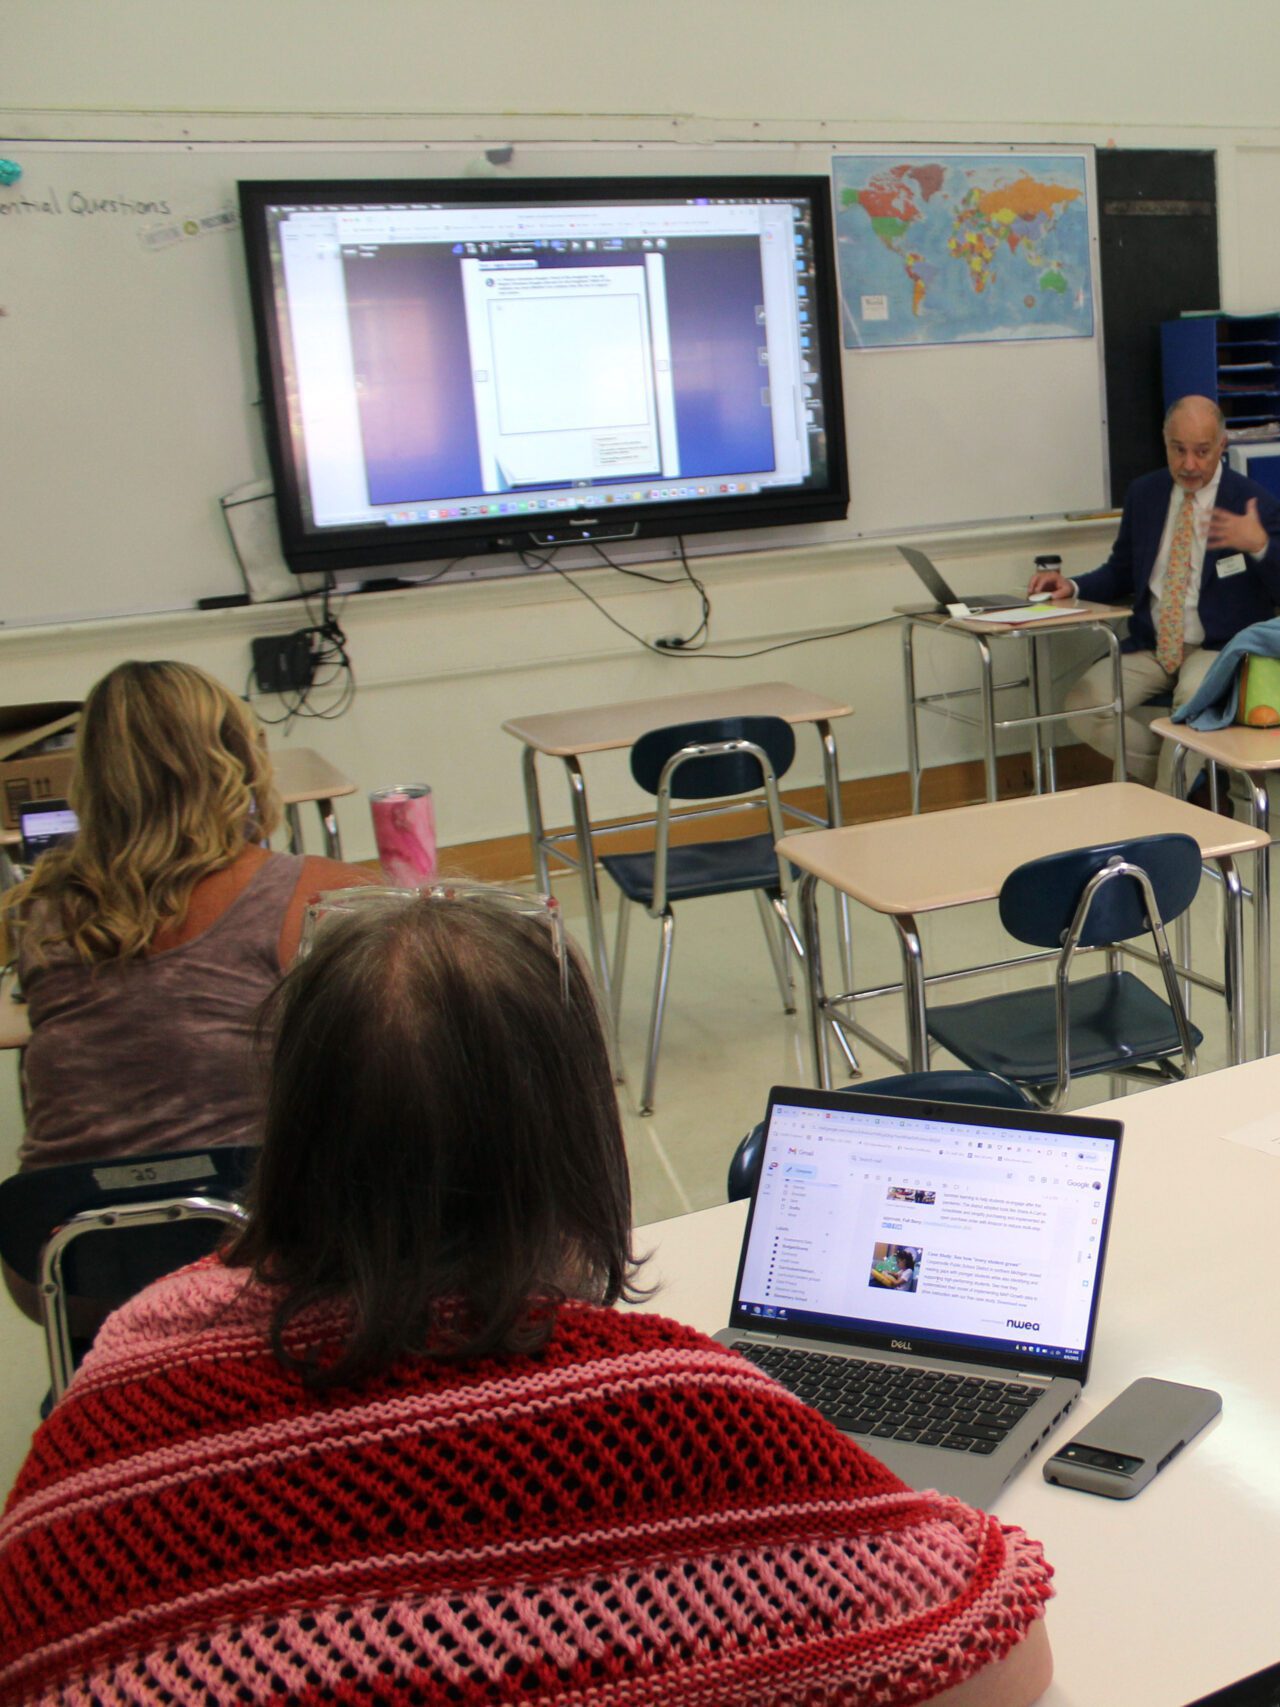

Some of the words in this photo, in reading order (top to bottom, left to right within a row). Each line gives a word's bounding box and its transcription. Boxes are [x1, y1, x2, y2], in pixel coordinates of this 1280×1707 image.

[68, 190, 171, 216] Questions
[1066, 1178, 1090, 1189] Google
[1006, 1318, 1040, 1332] nwea
[890, 1339, 913, 1351] DELL
